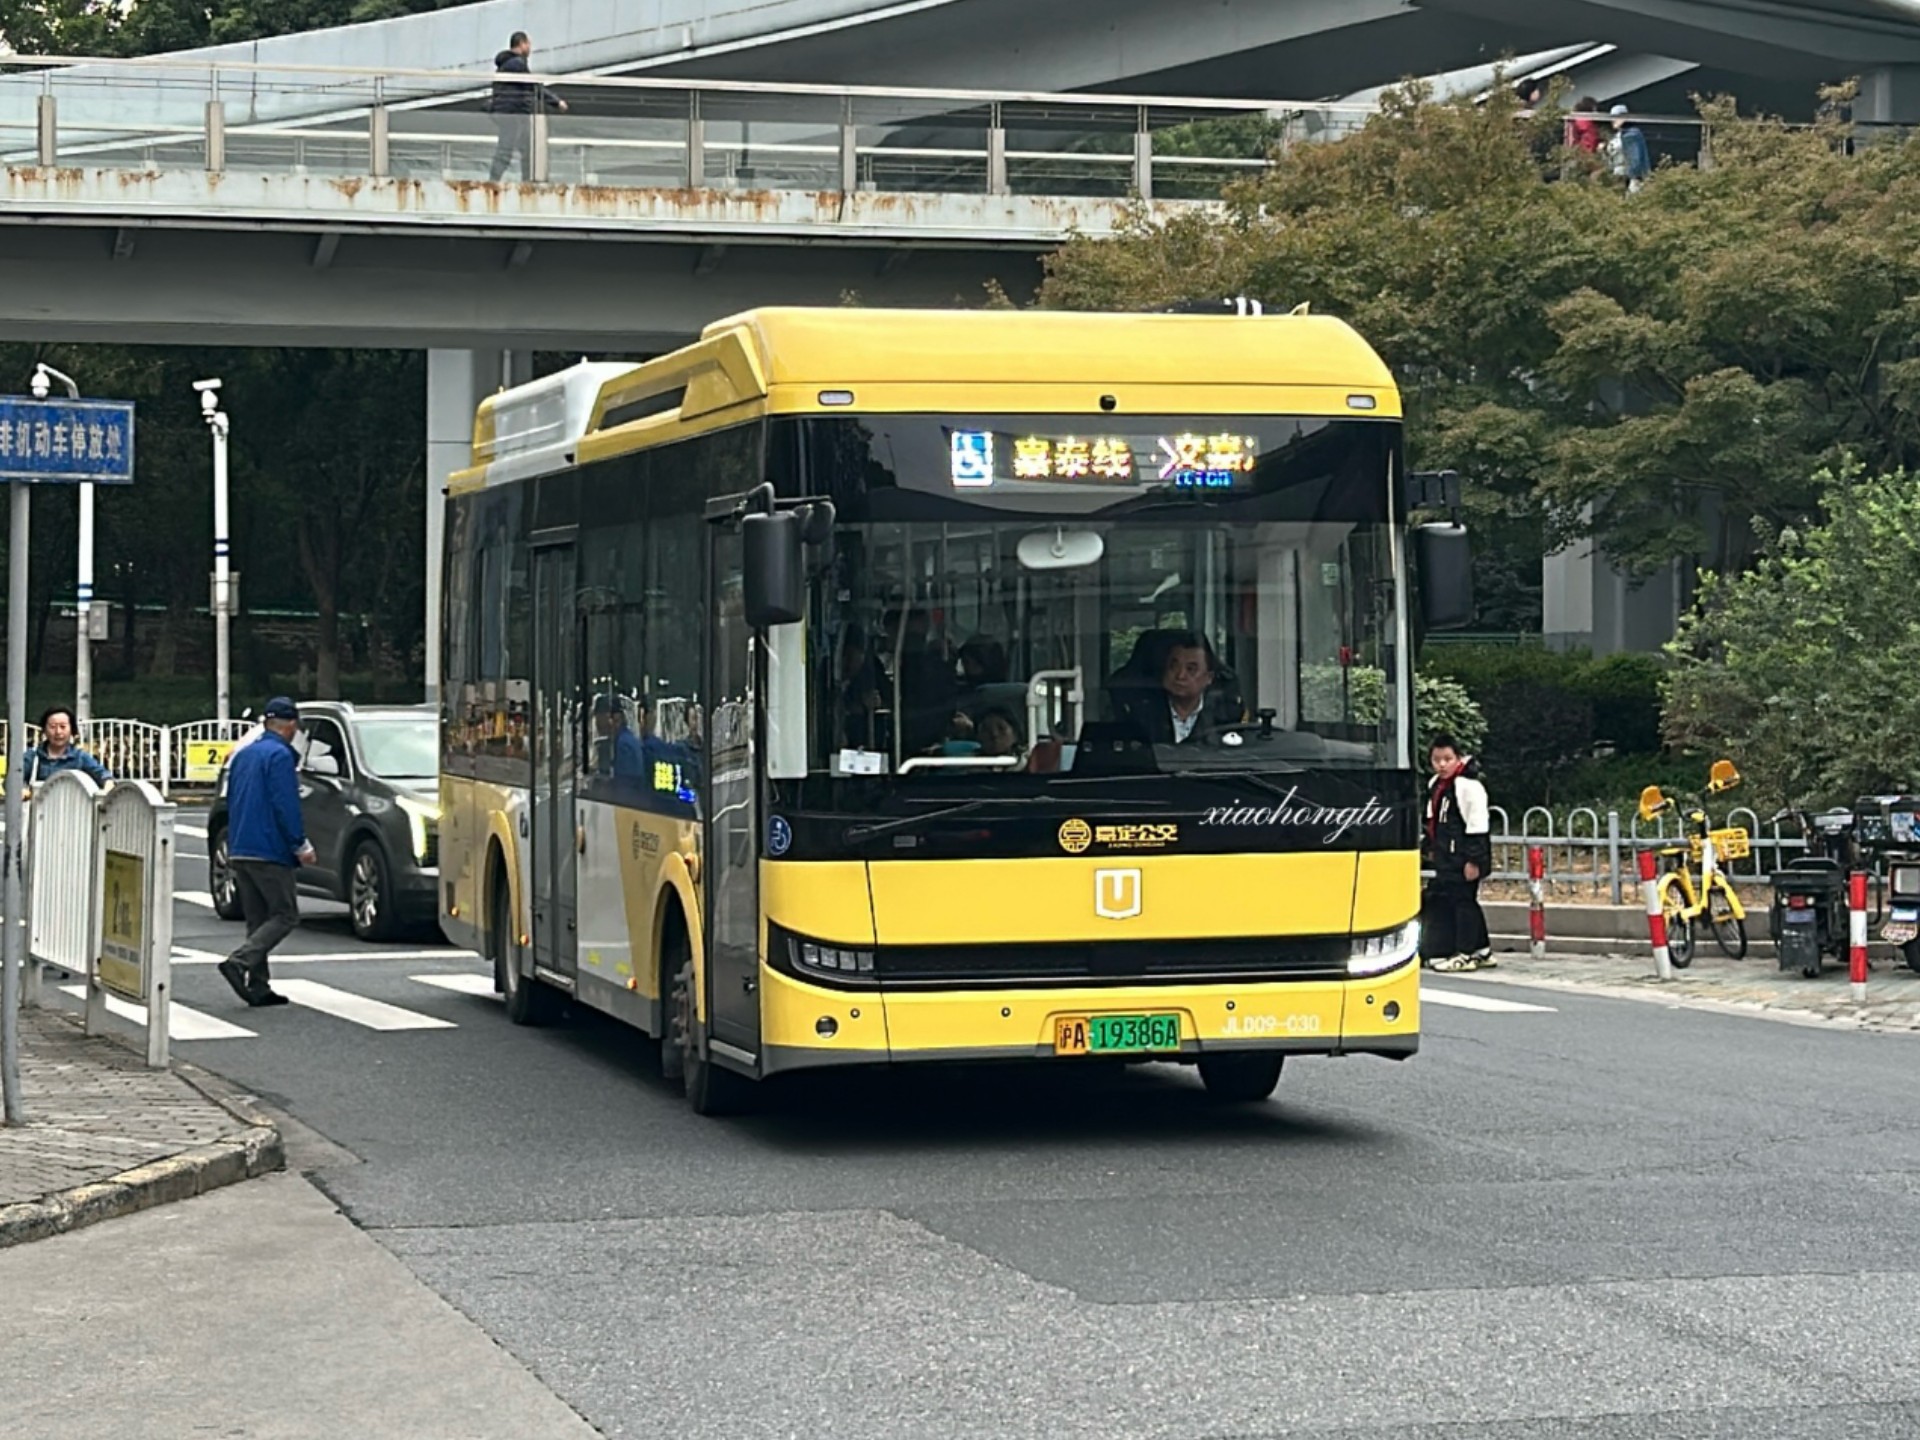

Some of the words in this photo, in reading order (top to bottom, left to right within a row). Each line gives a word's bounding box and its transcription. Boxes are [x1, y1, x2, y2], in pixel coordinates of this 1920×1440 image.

[1198, 785, 1394, 845] xiaohongtu
[1059, 1022, 1086, 1049] 沪A
[1099, 1019, 1178, 1049] 19386A
